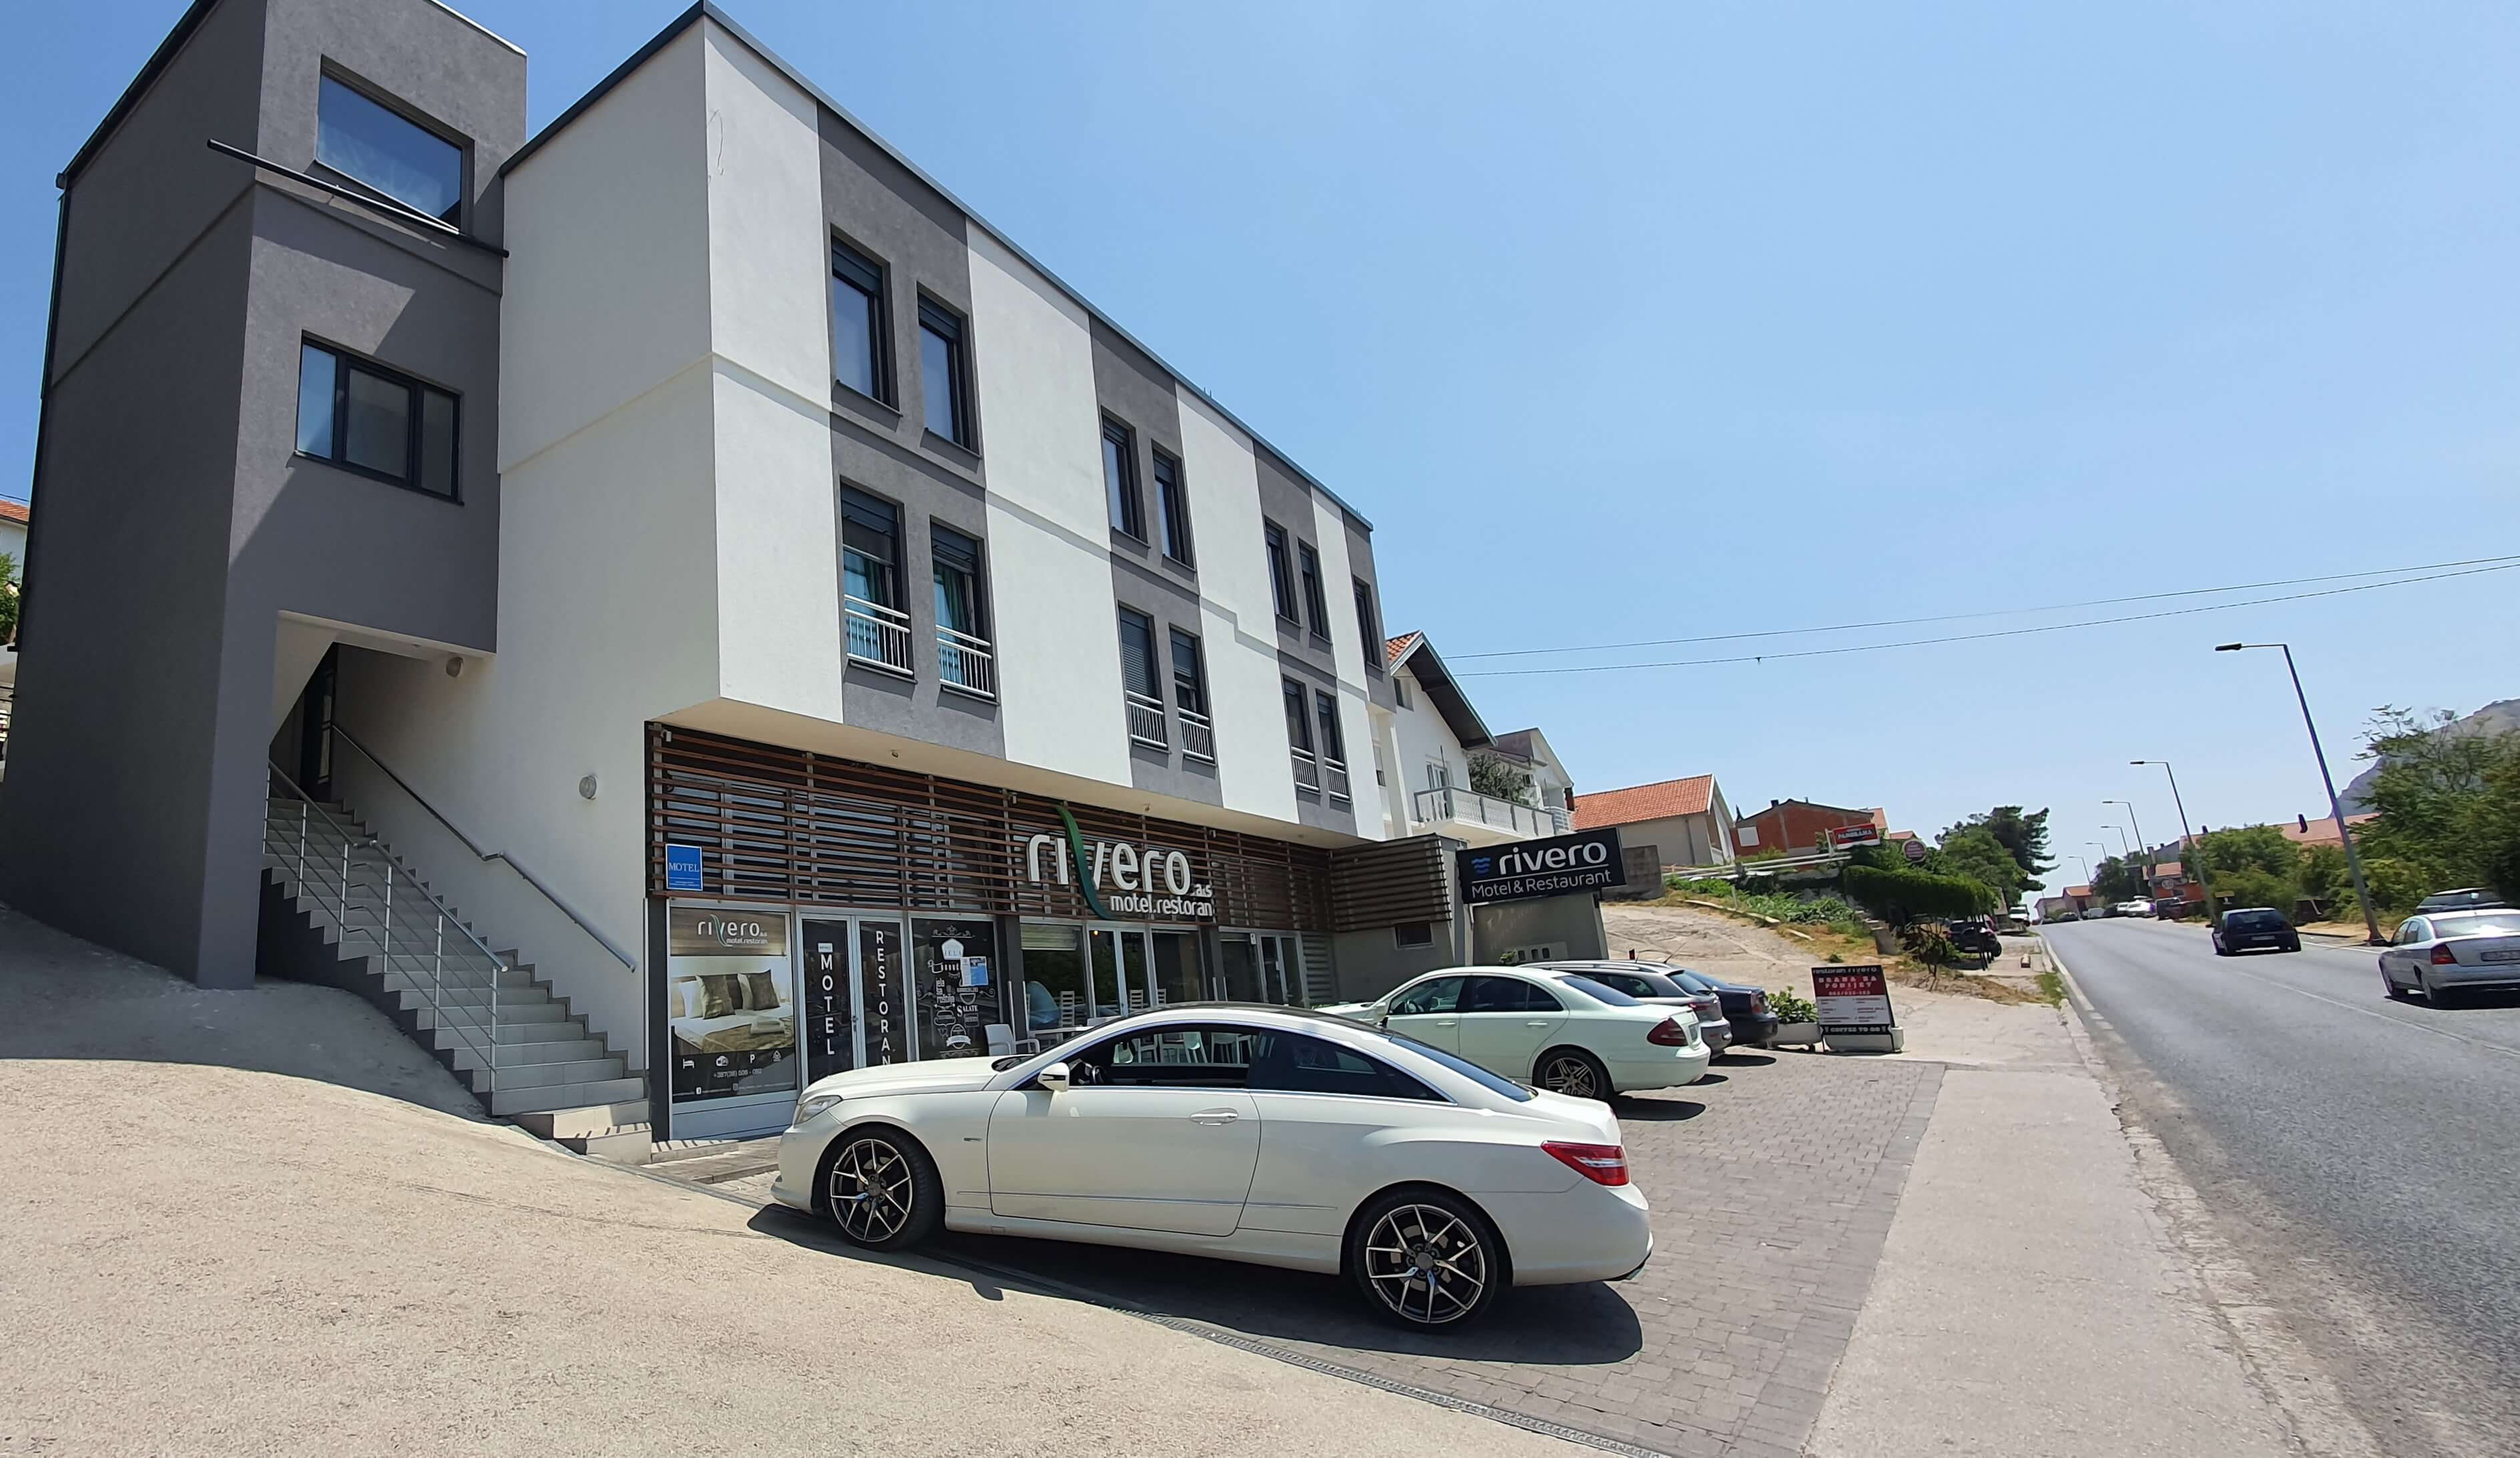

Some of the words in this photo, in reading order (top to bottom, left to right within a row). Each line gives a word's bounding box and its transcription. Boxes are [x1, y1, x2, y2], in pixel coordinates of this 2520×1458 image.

[668, 862, 700, 873] MOTEL
[1026, 834, 1191, 896] rivero
[1499, 842, 1607, 875] rivero
[1471, 881, 1511, 898] Motel
[1513, 879, 1525, 893] &
[1526, 869, 1612, 893] Restaurant
[1110, 894, 1213, 917] motel.restoran
[697, 921, 760, 937] rivero
[820, 954, 835, 1055] MOTEL
[876, 931, 891, 1065] RESTORAN
[957, 1005, 978, 1017] SALATE
